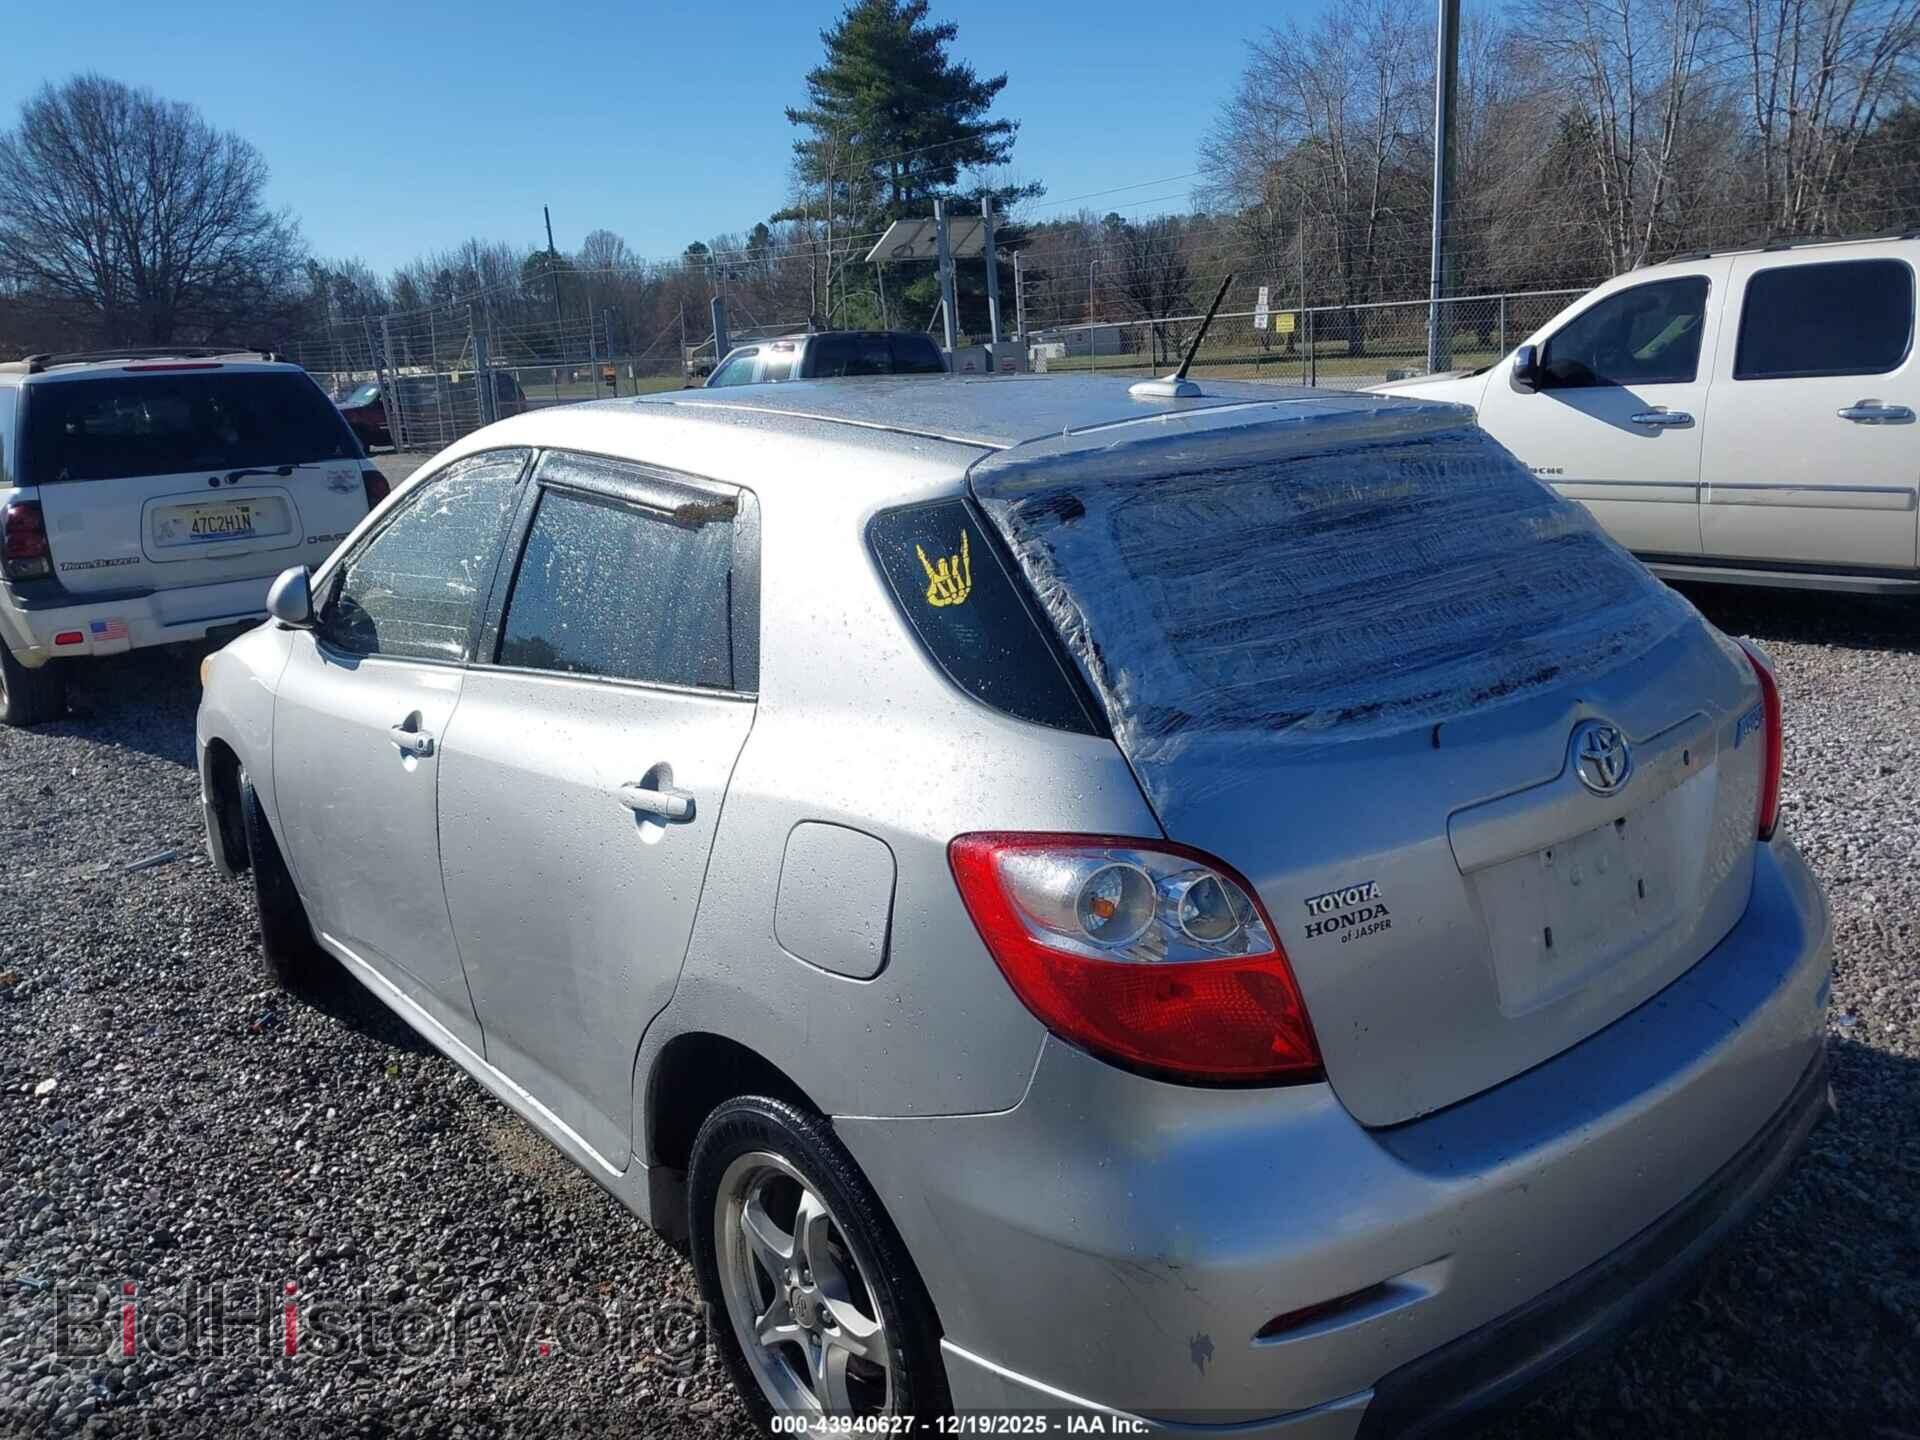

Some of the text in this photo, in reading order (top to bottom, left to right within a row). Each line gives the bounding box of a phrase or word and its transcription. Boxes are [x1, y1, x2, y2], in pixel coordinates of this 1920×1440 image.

[191, 514, 252, 533] 47C2H1N
[1306, 881, 1383, 916] TOYOTA
[1304, 903, 1390, 939] HONDA
[1341, 919, 1392, 943] of JASPER
